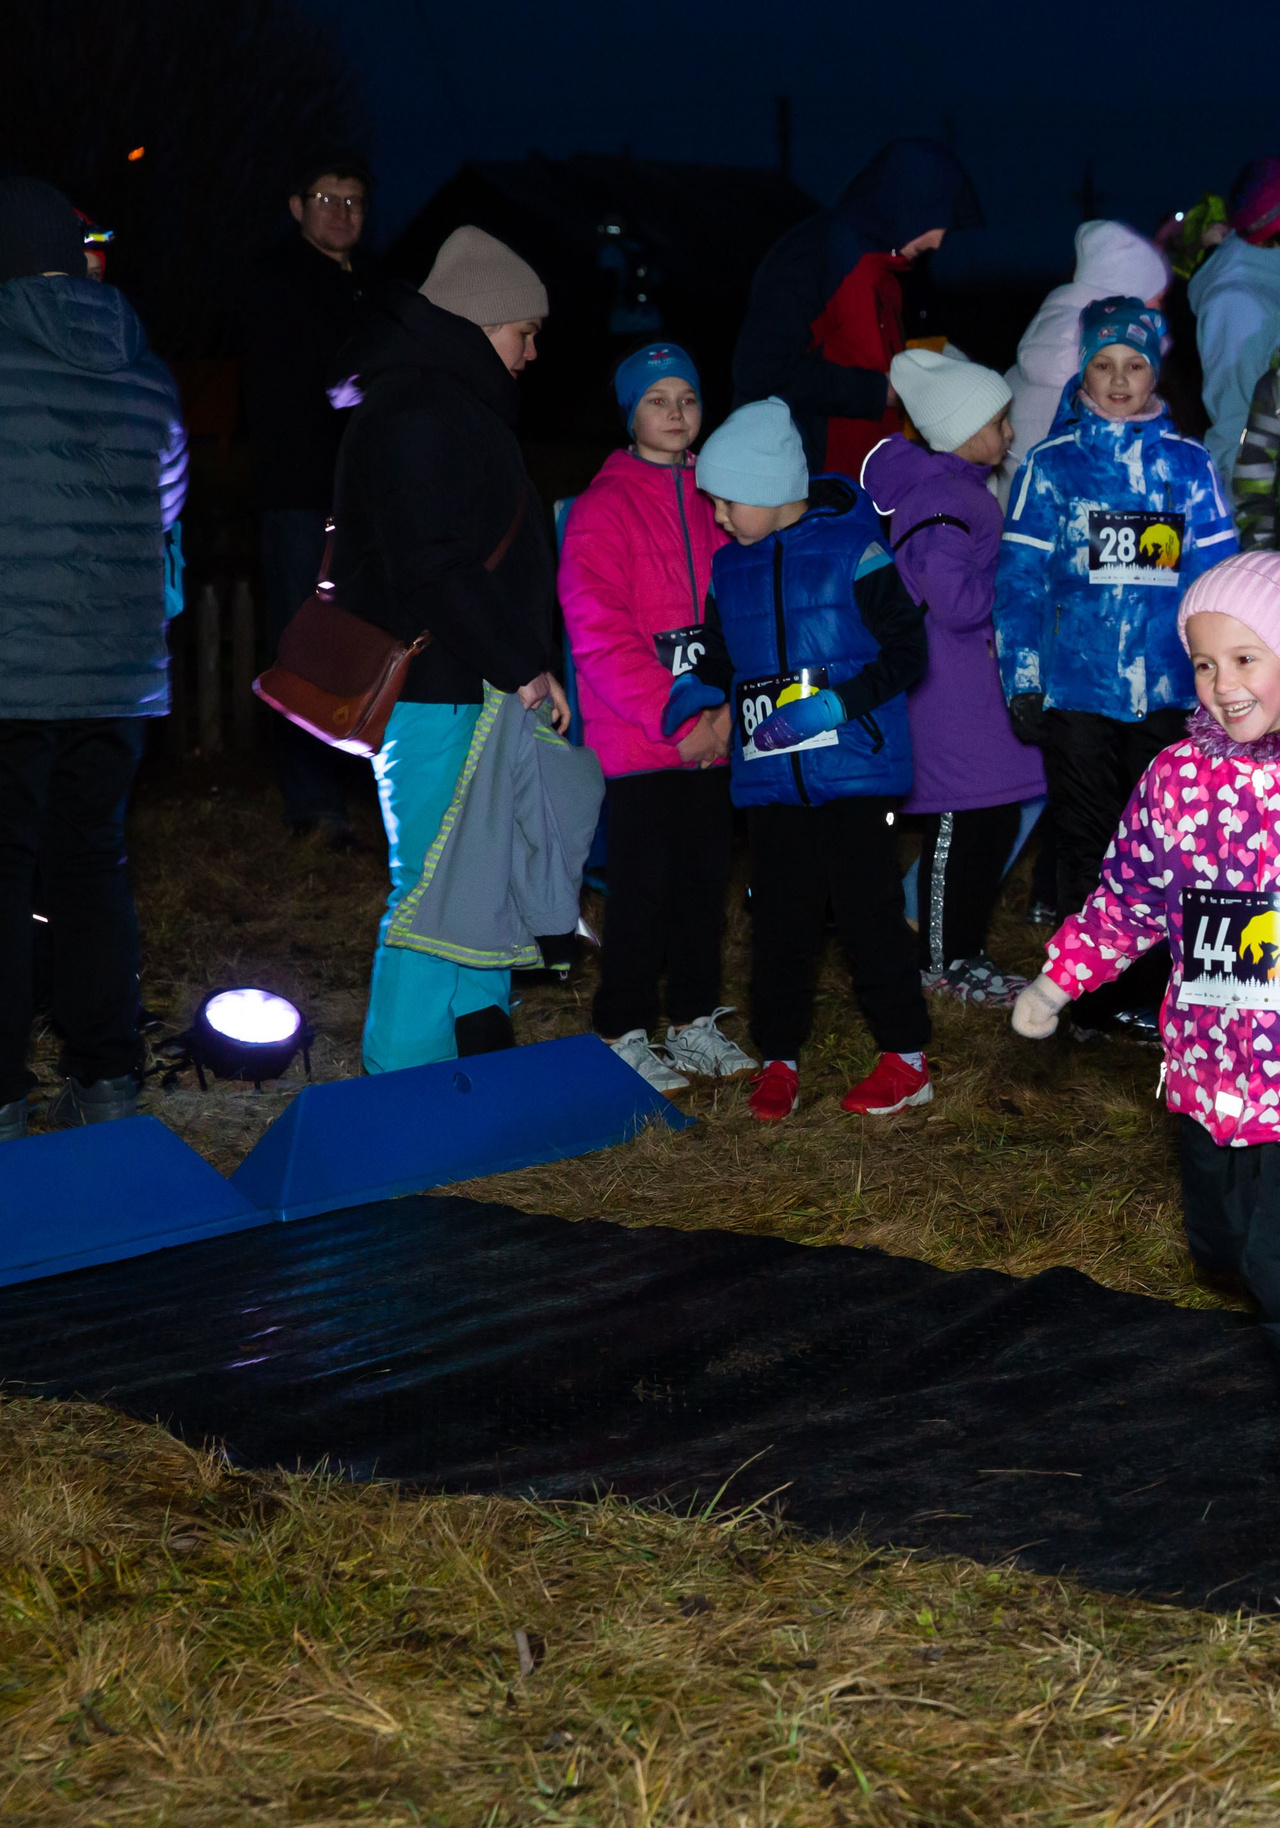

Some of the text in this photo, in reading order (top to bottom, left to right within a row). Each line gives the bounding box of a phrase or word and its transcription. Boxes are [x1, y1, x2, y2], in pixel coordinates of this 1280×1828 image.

[1099, 527, 1136, 562] 28
[742, 695, 773, 736] 80
[1193, 916, 1237, 972] 44
